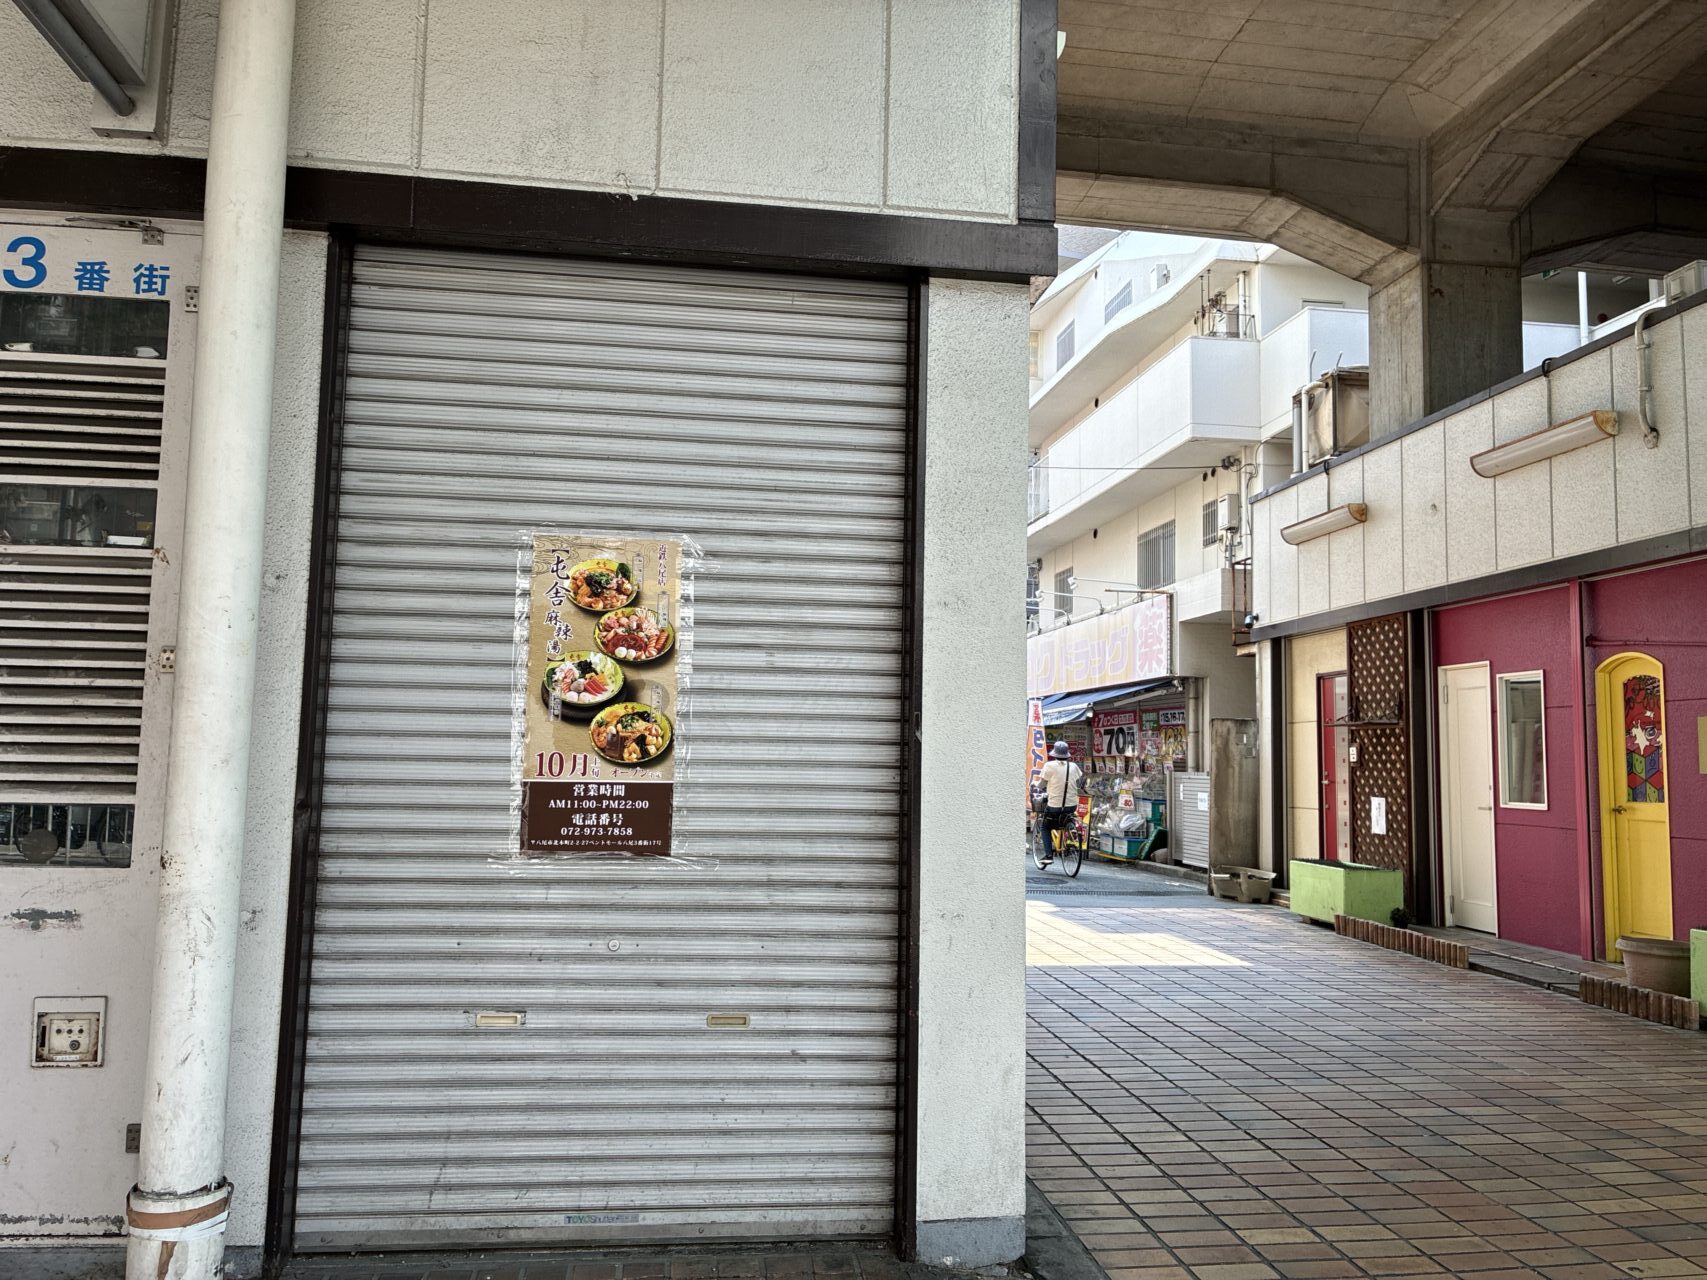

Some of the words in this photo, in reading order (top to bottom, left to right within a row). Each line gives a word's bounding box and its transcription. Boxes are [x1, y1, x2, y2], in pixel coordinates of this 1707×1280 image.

[3, 236, 170, 296] 3番街
[536, 751, 588, 777] 10月
[611, 766, 648, 778] オープン
[573, 784, 625, 796] 営業時間
[571, 813, 623, 825] 電話番号
[561, 827, 633, 835] 072-973-7858
